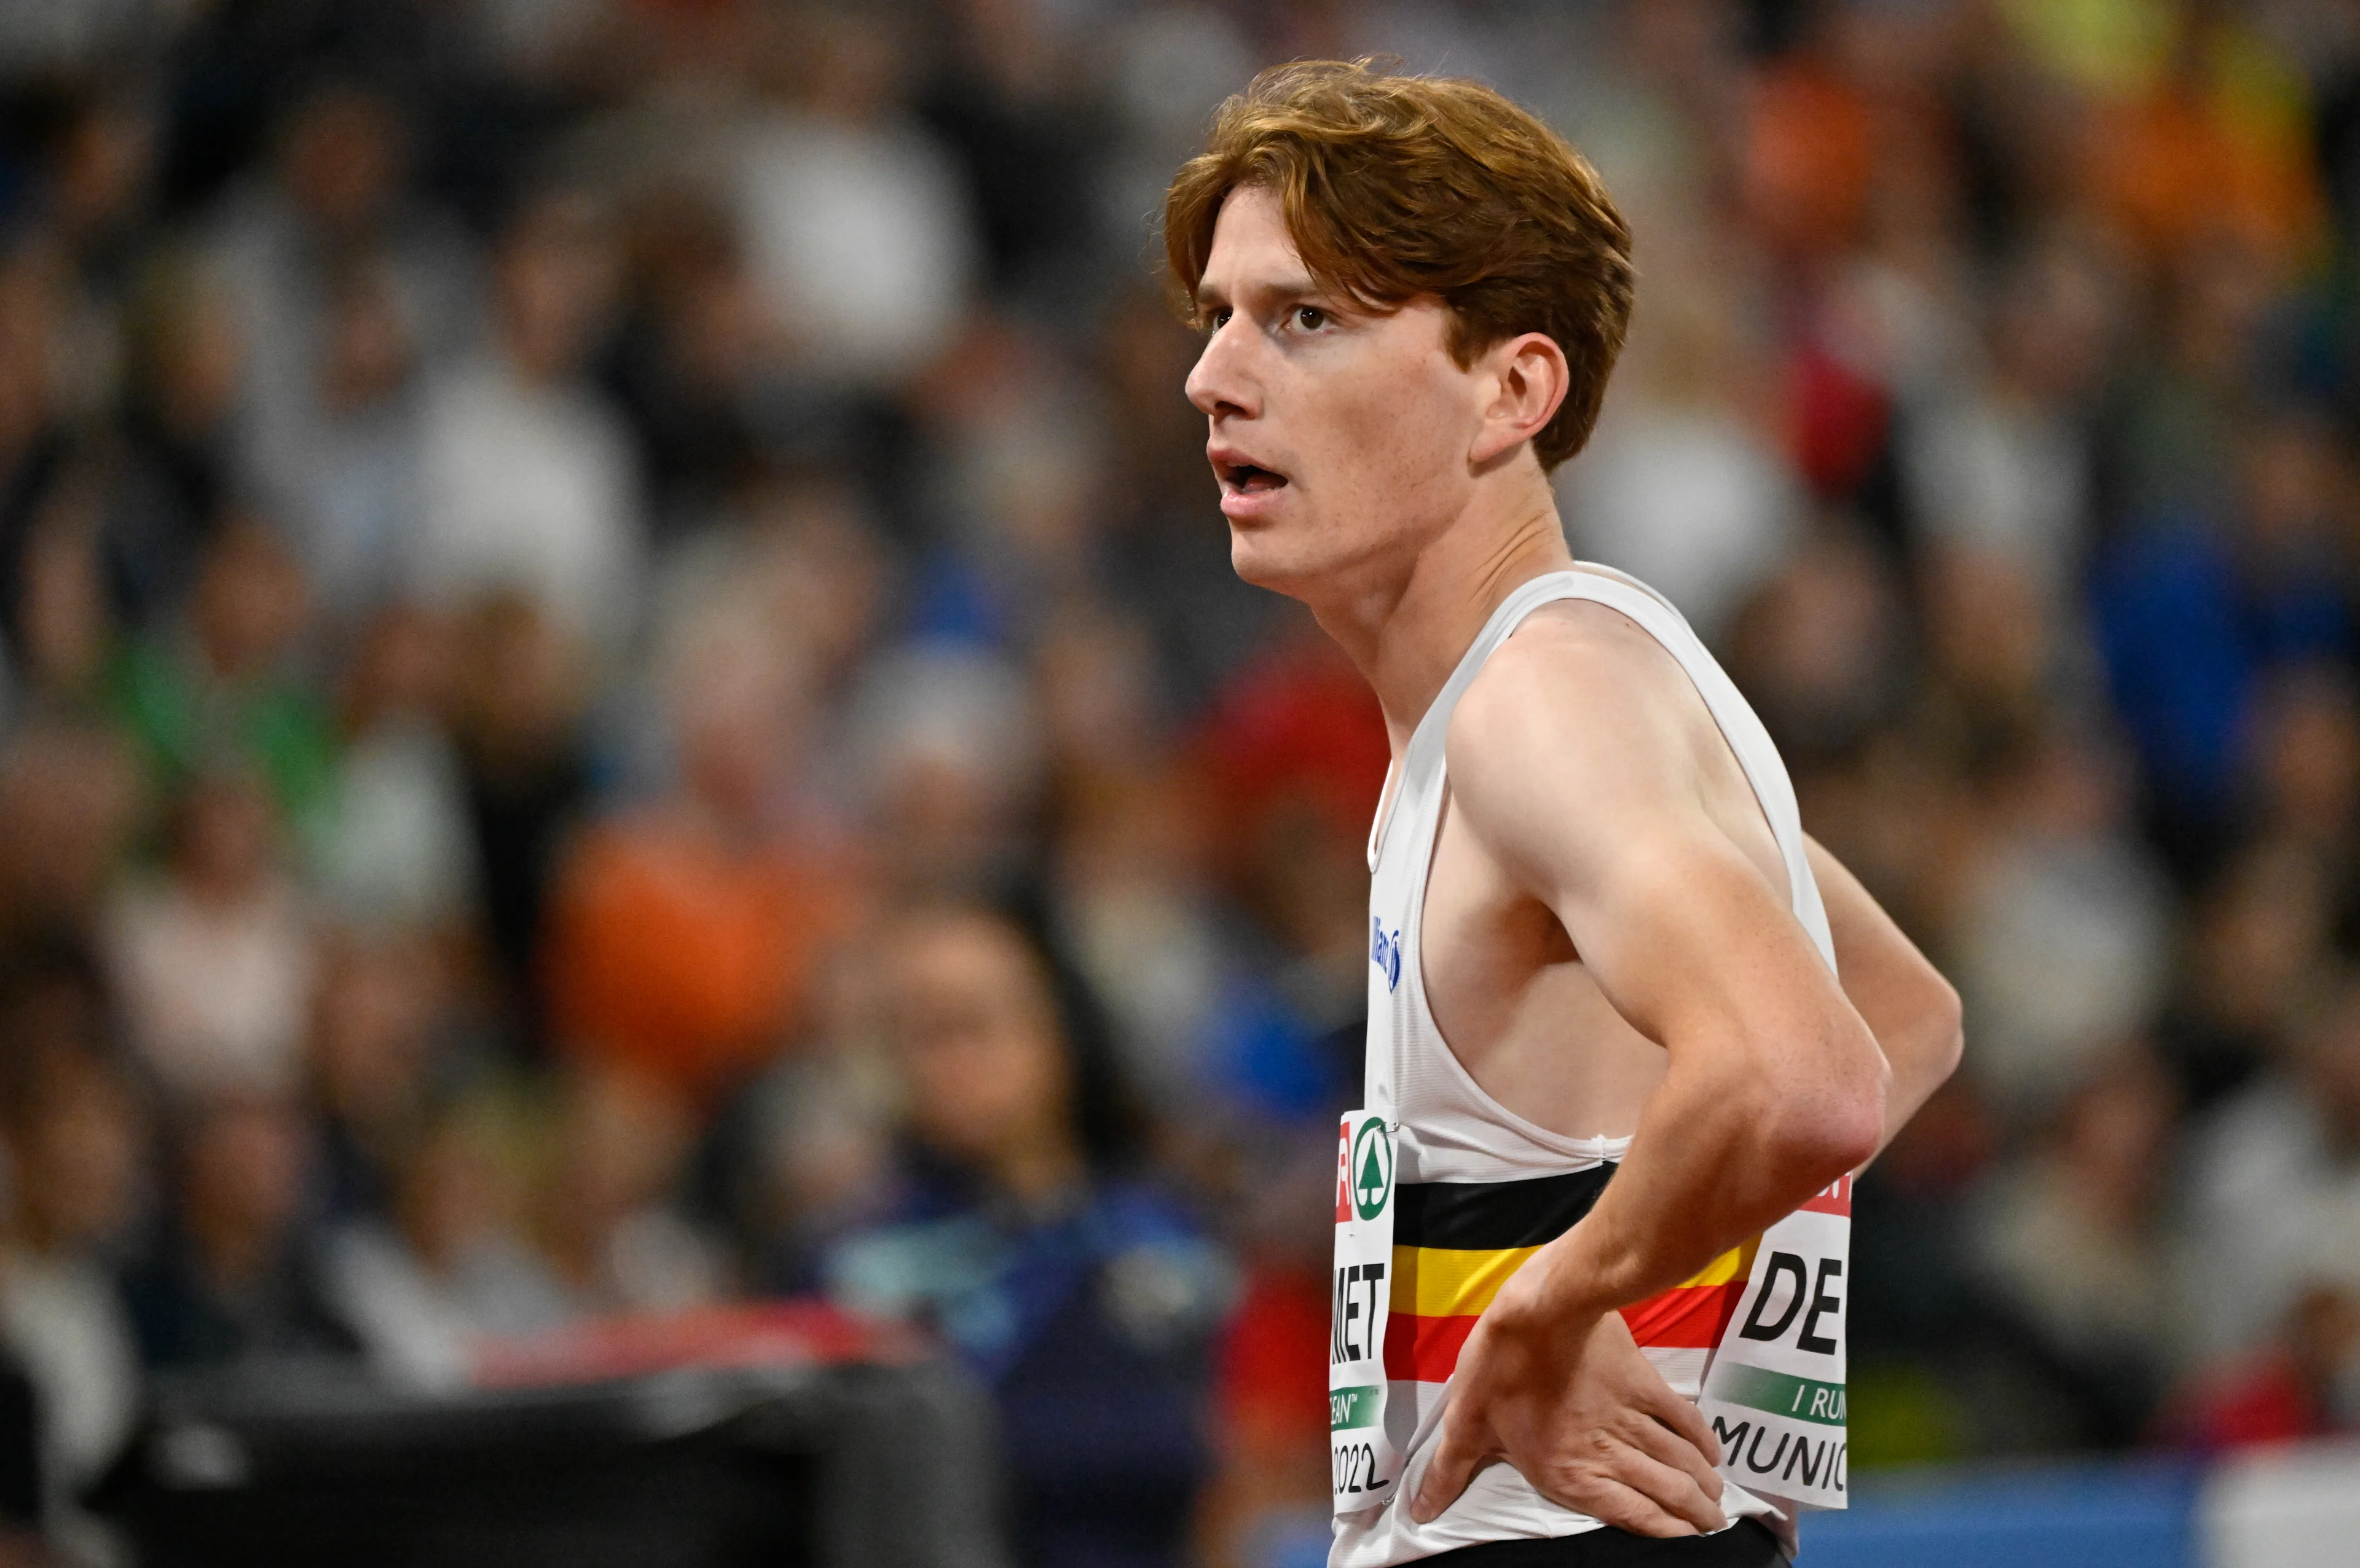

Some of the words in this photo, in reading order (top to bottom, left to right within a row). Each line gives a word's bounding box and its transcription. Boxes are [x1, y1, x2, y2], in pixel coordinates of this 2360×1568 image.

[1739, 1251, 1843, 1355] DE
[1792, 1384, 1806, 1412] I
[1334, 1443, 1390, 1495] 2022
